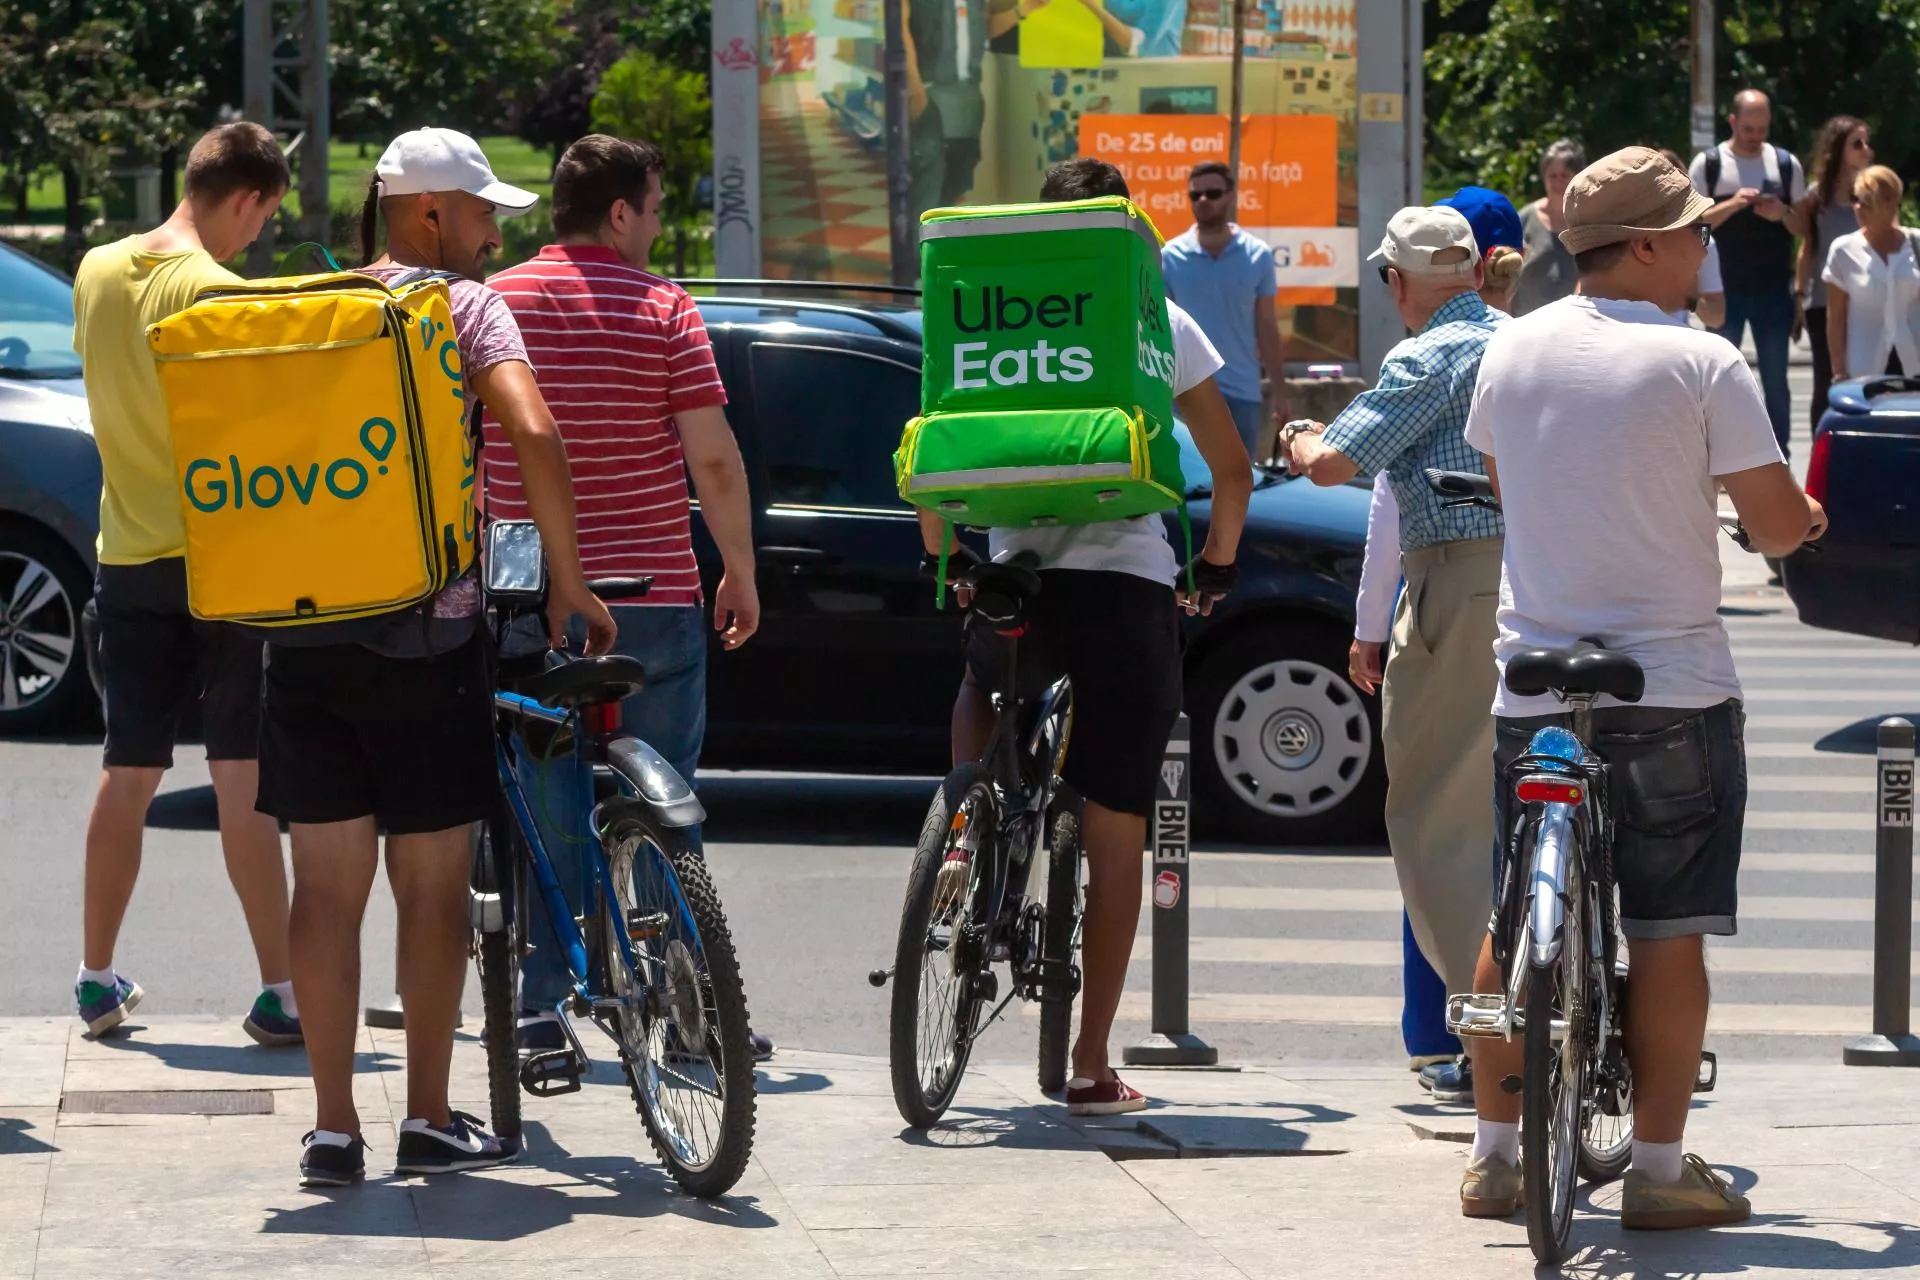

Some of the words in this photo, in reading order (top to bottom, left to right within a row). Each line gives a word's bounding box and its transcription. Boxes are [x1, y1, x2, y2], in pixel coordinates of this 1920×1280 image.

[1096, 132, 1124, 152] De
[1129, 132, 1155, 153] 25
[1160, 132, 1186, 153] de
[1191, 132, 1224, 153] ani
[1137, 165, 1161, 181] cu
[953, 285, 1093, 333] Uber
[953, 339, 1094, 389] Eats
[1138, 319, 1175, 389] Eats
[184, 453, 369, 513] Glovo
[1884, 769, 1912, 822] BNE
[1158, 805, 1187, 859] BNE
